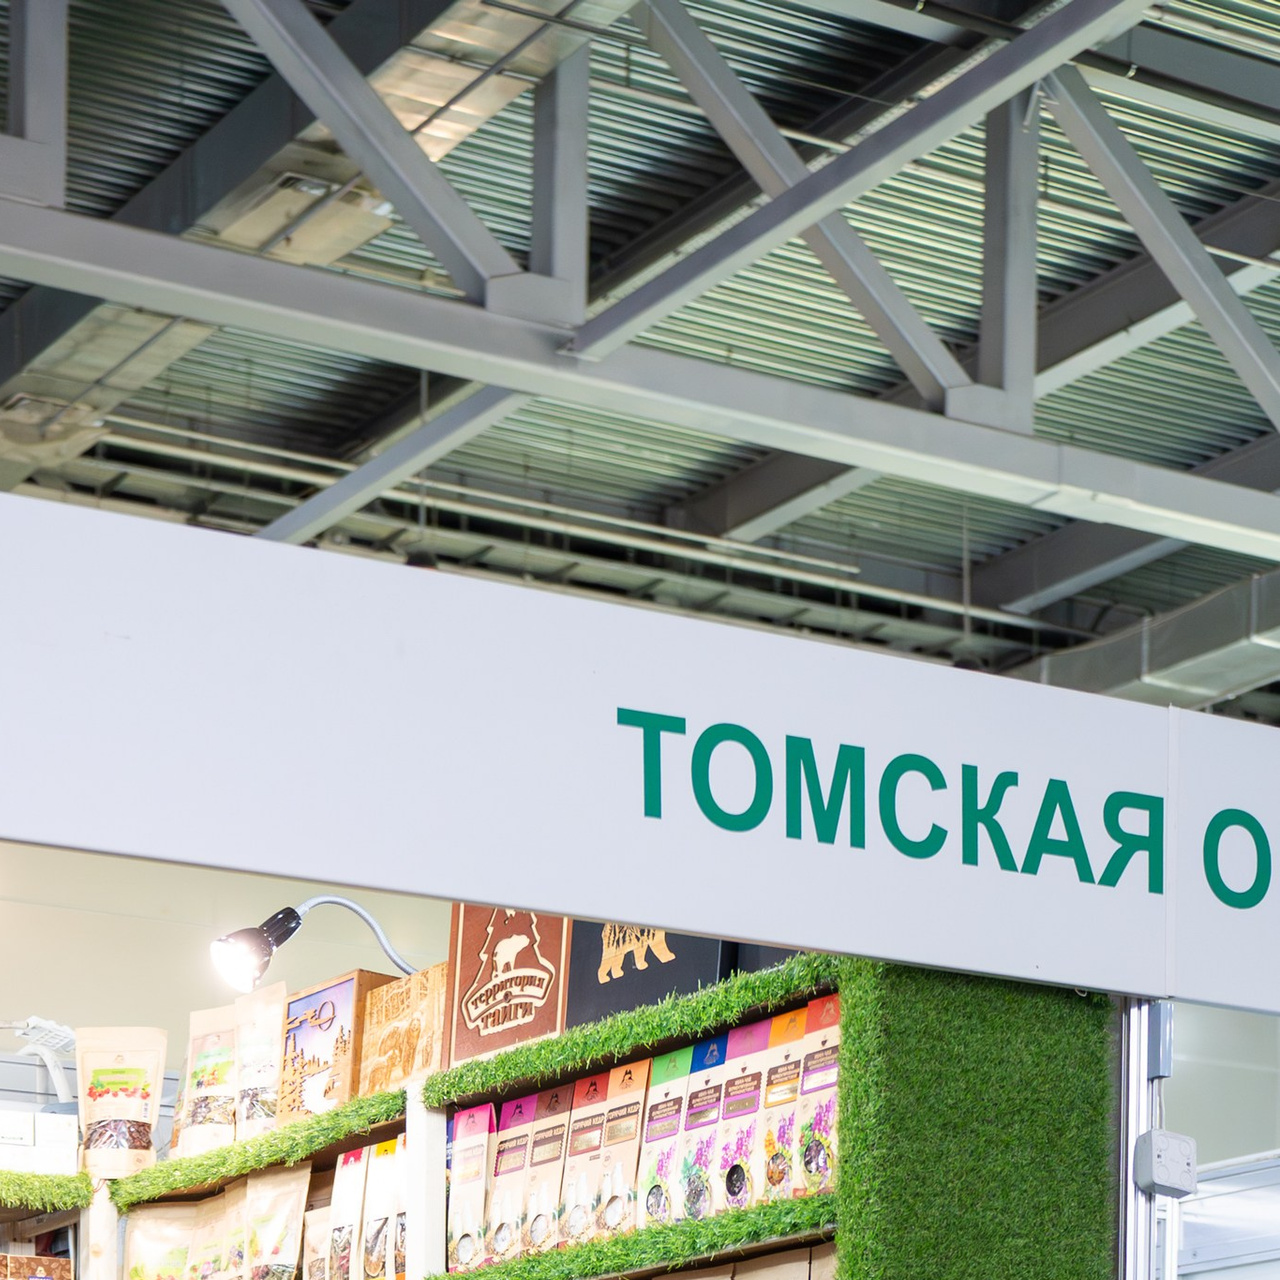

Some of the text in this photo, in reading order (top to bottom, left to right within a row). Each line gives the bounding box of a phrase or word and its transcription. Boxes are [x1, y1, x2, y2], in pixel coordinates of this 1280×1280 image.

[617, 706, 1273, 910] ТОМСКАЯ О
[470, 974, 546, 1011] территория
